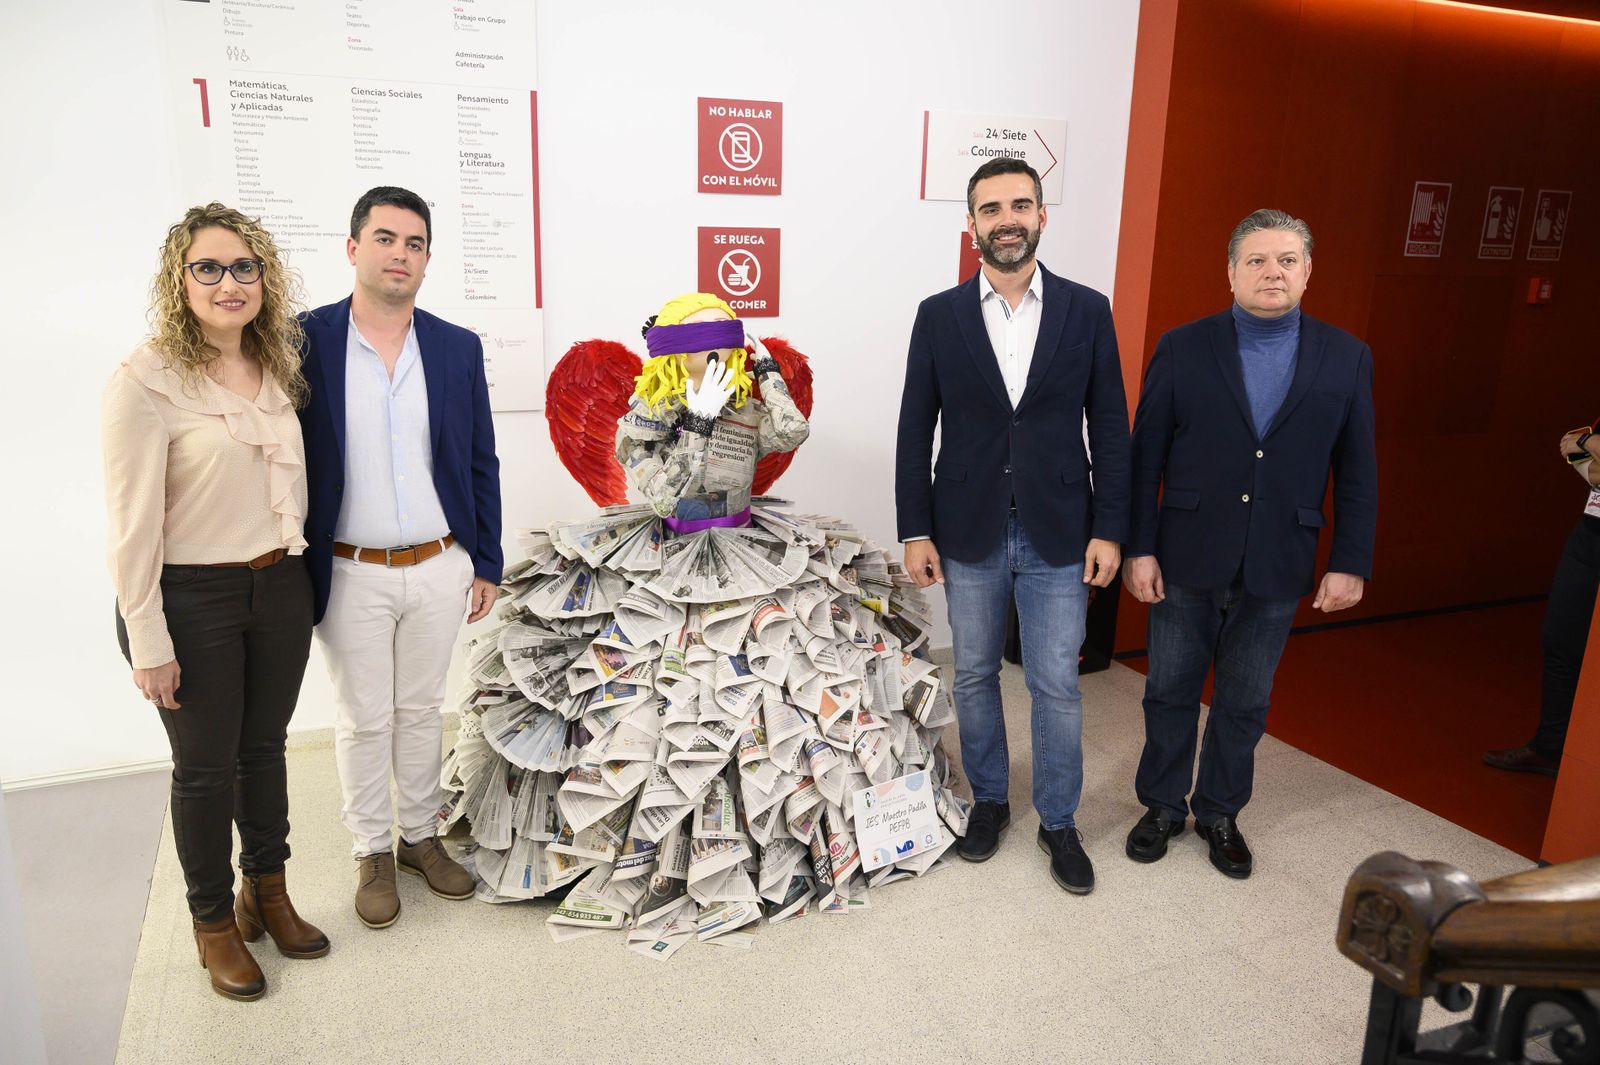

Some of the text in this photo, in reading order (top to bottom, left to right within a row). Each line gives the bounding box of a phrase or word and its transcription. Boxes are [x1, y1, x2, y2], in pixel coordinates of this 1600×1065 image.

[453, 13, 477, 23] Trabajo
[486, 16, 506, 25] Grupo
[455, 51, 504, 60] Administración
[455, 61, 485, 69] Cafetería
[229, 80, 288, 91] Matemáticas,
[230, 90, 314, 102] Ciencias Naturales
[350, 86, 423, 99] Ciencias Sociales
[457, 94, 509, 104] Pensamiento
[239, 102, 284, 112] Aplicadas
[232, 112, 259, 120] Naturaleza
[709, 106, 772, 120] NO HABLAR
[986, 128, 1027, 141] 24/Siete
[460, 150, 492, 160] Lenguas
[970, 146, 1026, 159] Colombine
[466, 159, 505, 168] Literatura
[702, 174, 778, 188] CON EL MÓVIL
[714, 234, 765, 245] SE RUEGA
[730, 300, 767, 310] COMER
[720, 426, 755, 440] feminismo
[714, 442, 746, 453] denuncia
[746, 448, 752, 456] la
[865, 814, 880, 829] IES
[882, 809, 907, 824] Maestro
[908, 800, 927, 815] Padilla
[634, 858, 644, 866] del
